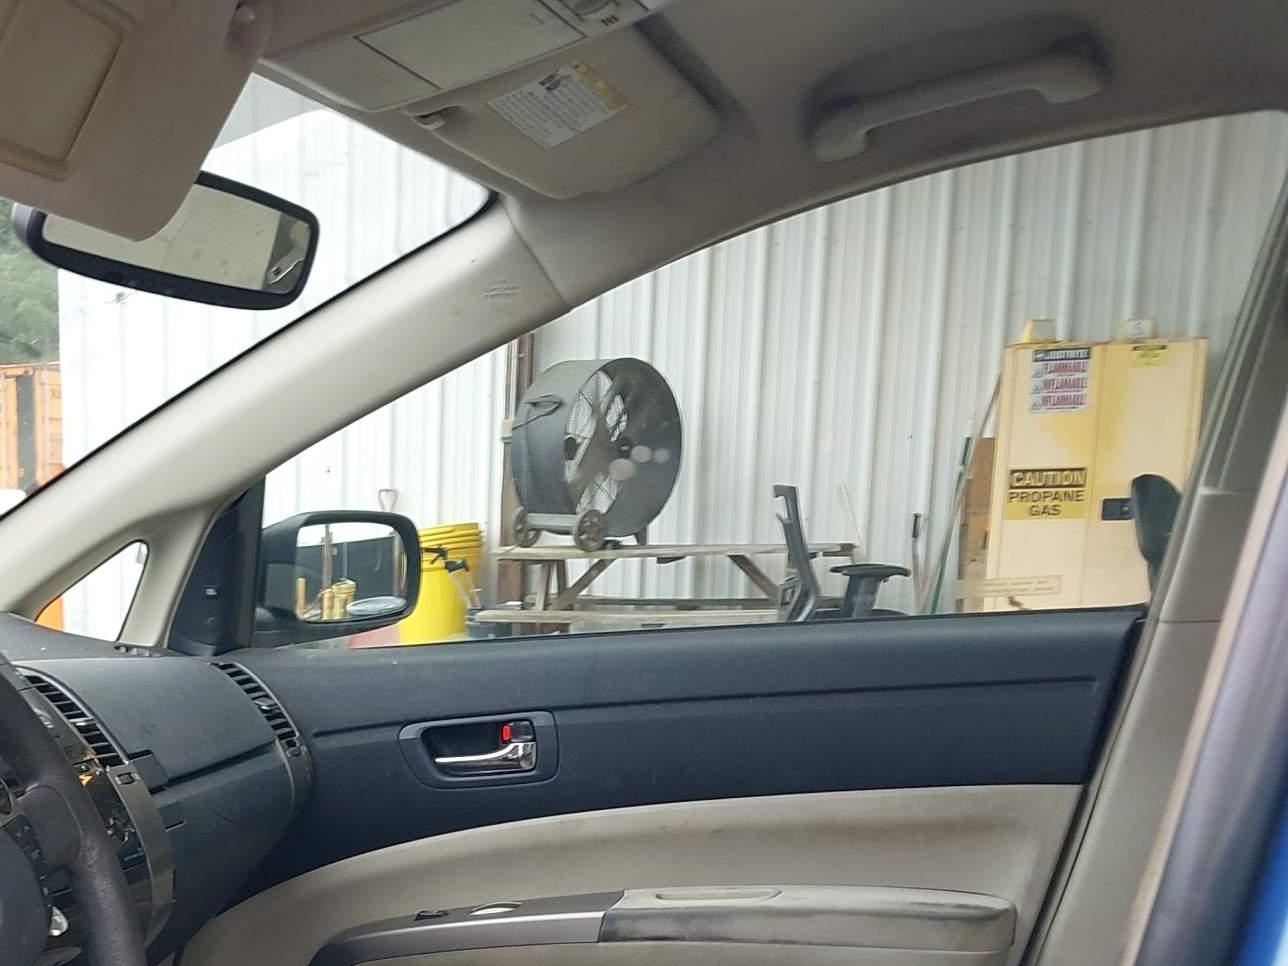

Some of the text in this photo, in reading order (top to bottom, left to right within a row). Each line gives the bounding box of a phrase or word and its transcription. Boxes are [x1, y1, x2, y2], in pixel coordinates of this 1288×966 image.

[1011, 470, 1086, 487] CAUTION
[1008, 490, 1085, 503] PROPANE
[1030, 504, 1061, 516] GAS
